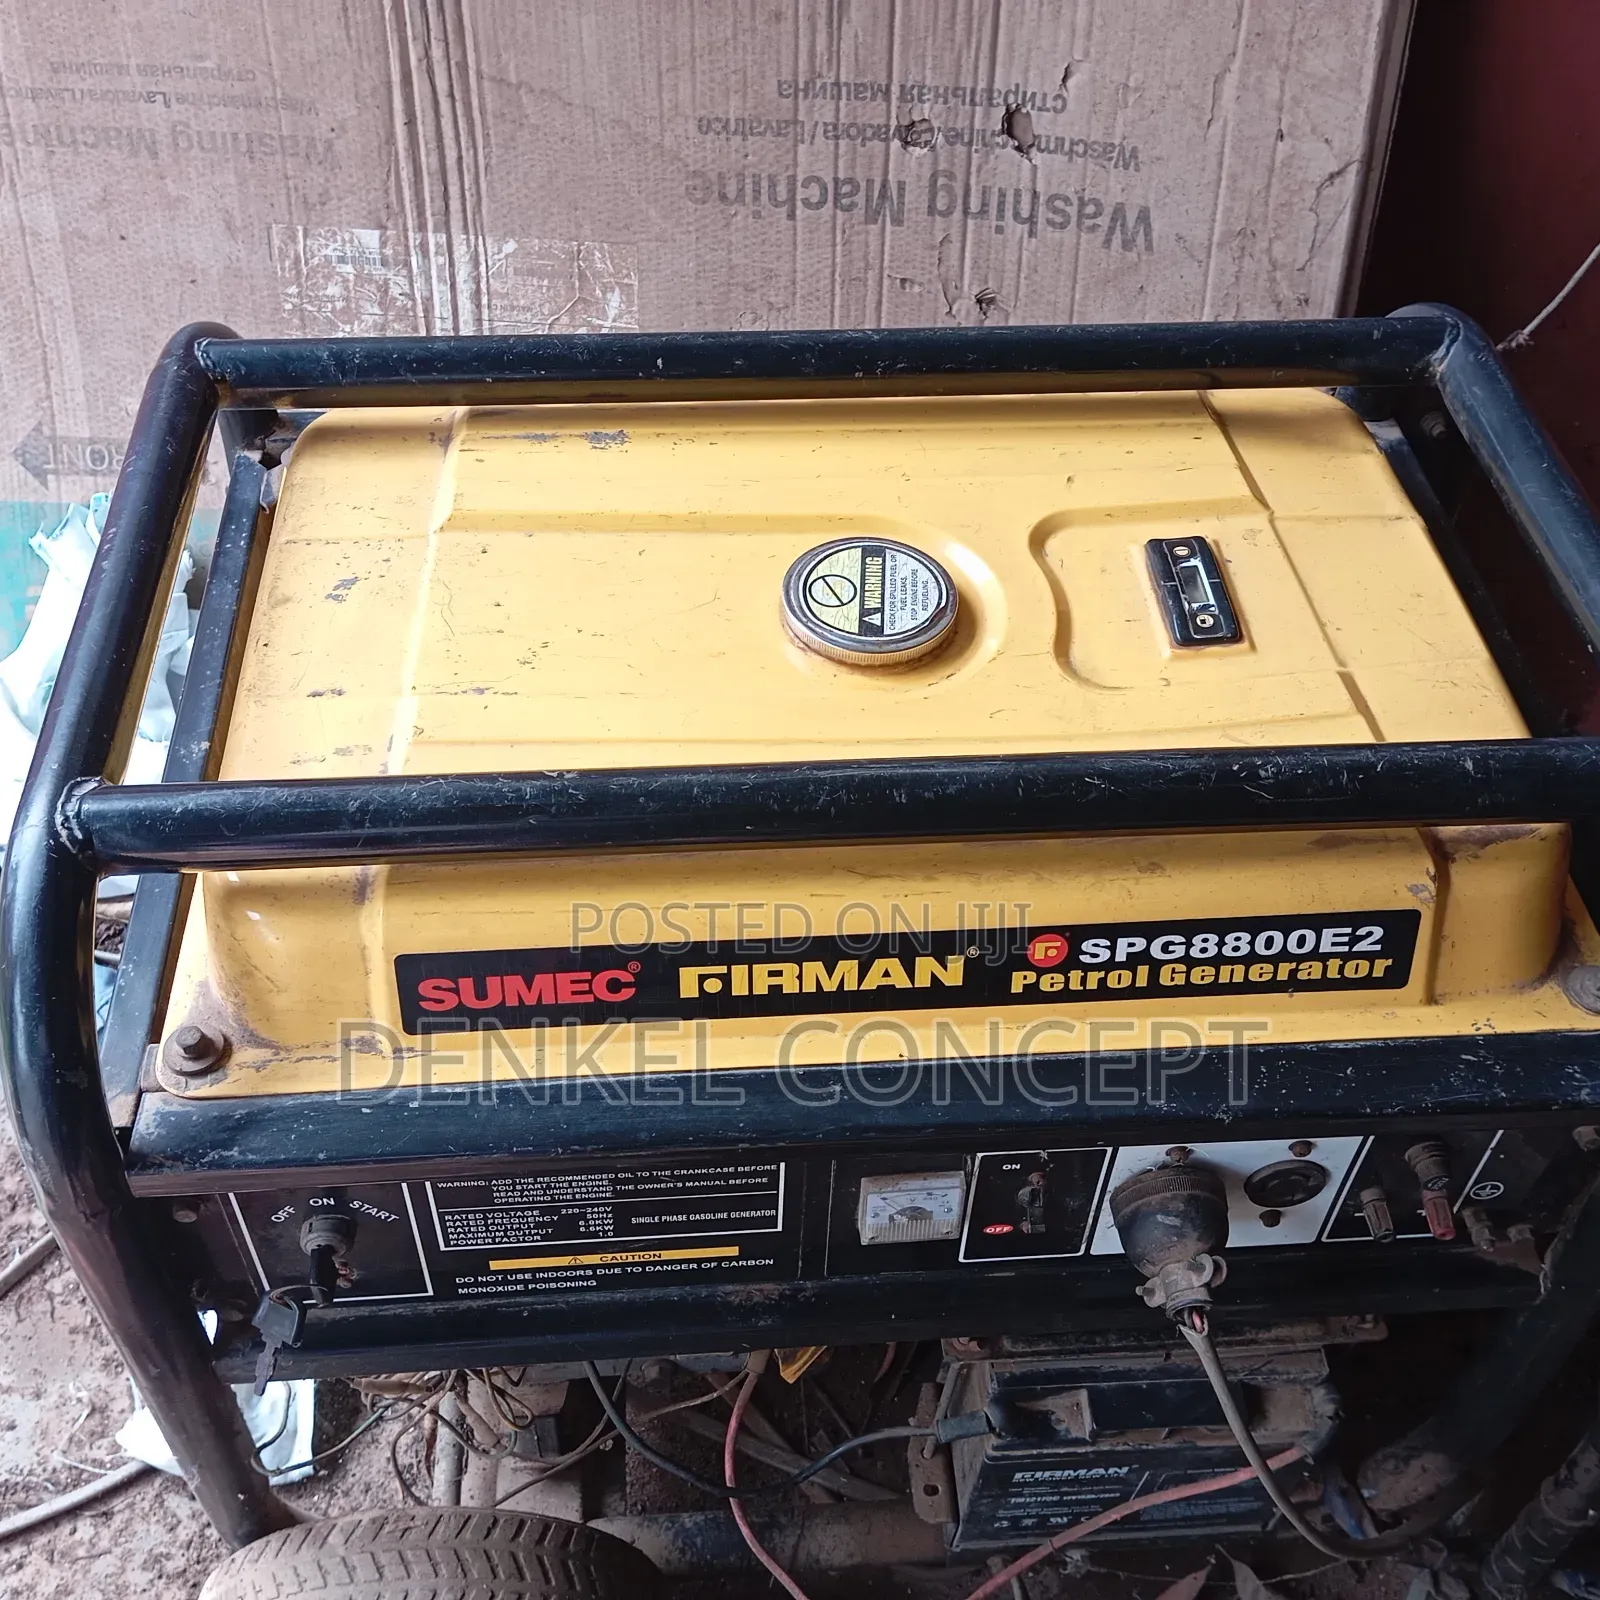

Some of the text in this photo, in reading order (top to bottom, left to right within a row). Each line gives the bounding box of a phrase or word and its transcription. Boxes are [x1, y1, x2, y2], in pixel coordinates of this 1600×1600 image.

[777, 80, 891, 102] машина
[684, 169, 1154, 253] Washing Machine
[890, 564, 898, 577] FUEL
[864, 556, 883, 609] WARNING
[910, 569, 919, 621] STOP ENGINE BEFORE
[889, 601, 897, 612] FOR
[1079, 926, 1384, 964] SPG8800E2
[1010, 955, 1393, 994] Petrol Generator
[537, 1173, 615, 1183] RECOMMENDED
[674, 1167, 735, 1175] CRANKCASE
[737, 1164, 778, 1172] BEFORE
[546, 1185, 613, 1195] UNDERSTAND
[637, 1182, 683, 1190] OWNER'S
[729, 1177, 768, 1185] BEFORE
[493, 1196, 551, 1204] OPERATING
[271, 1197, 400, 1222] OFF ON START
[444, 1213, 483, 1221] RATED
[485, 1210, 540, 1218] VOLTAGE
[631, 1209, 776, 1224] SINGLE PHASE GASOLINE GENERATOR
[487, 1215, 559, 1225] FREQUENCY
[447, 1226, 487, 1234] RATED
[488, 1223, 535, 1231] OUTPUT
[449, 1231, 509, 1239] MAXIMUM
[511, 1228, 554, 1236] OUTPUT
[985, 1225, 1011, 1233] OFF
[450, 1238, 498, 1246] POWER
[499, 1235, 542, 1243] FACTOR
[599, 1252, 662, 1263] CAUTION
[478, 1274, 504, 1283] NOT
[508, 1272, 533, 1281] USE
[536, 1269, 593, 1279] INDOORS
[596, 1268, 621, 1276] DUE
[646, 1262, 698, 1273] DANGER
[701, 1261, 718, 1269] OF
[722, 1258, 774, 1268] CARBON
[458, 1279, 597, 1295] MONOXIDE POISONING
[1014, 1466, 1130, 1480] FIRMAN
